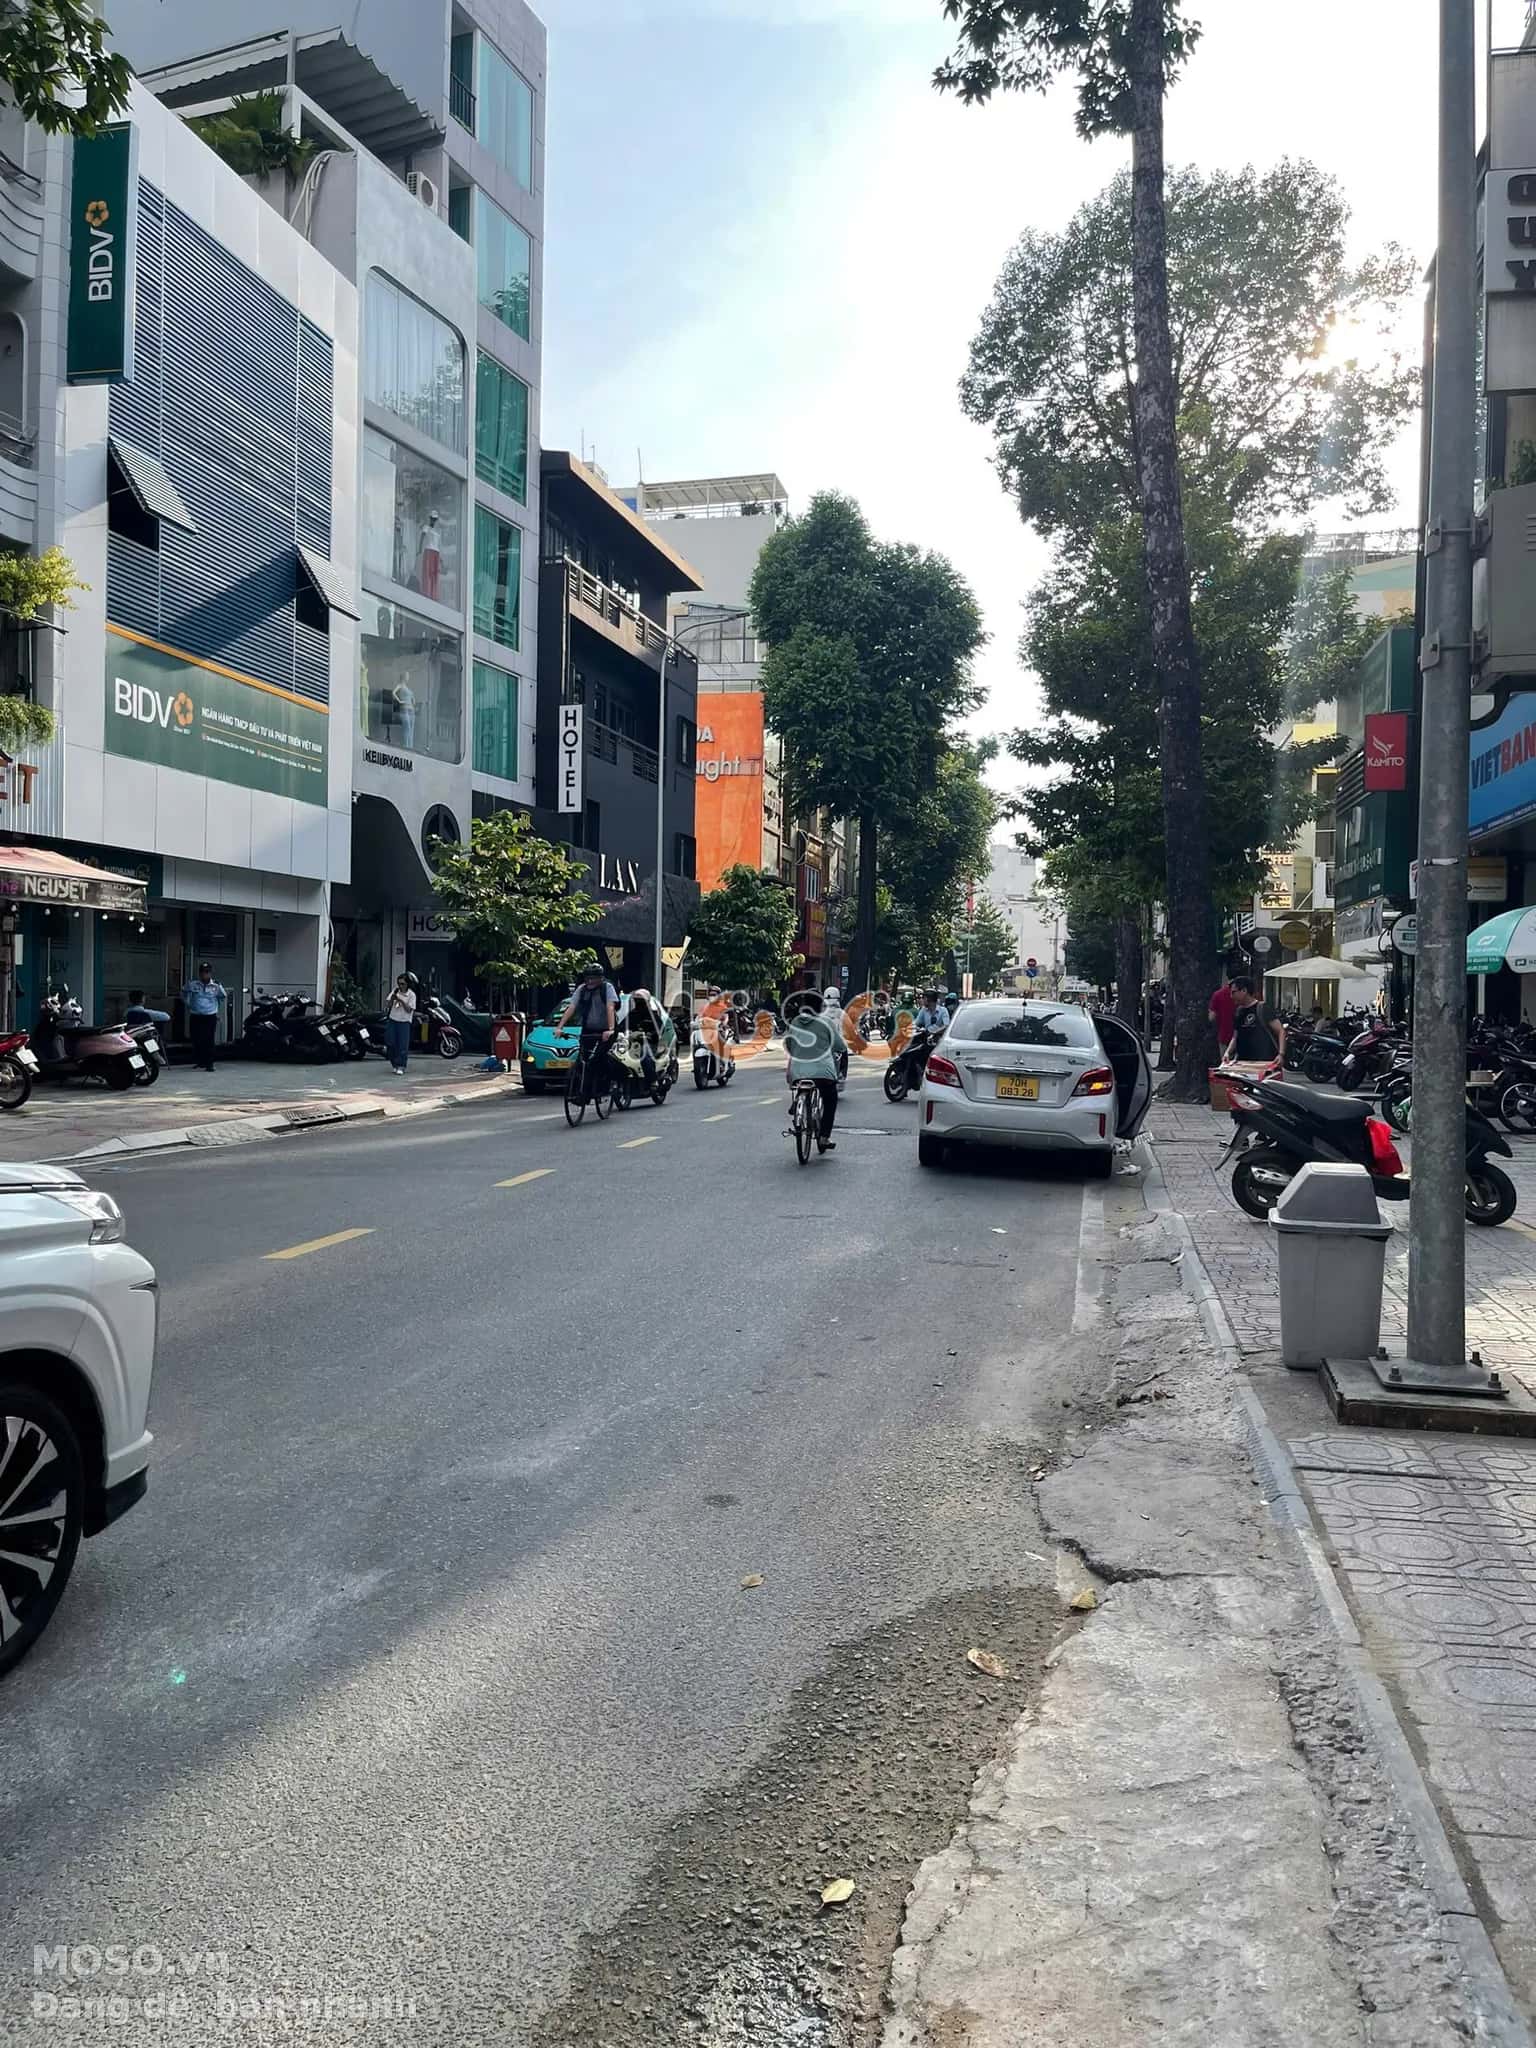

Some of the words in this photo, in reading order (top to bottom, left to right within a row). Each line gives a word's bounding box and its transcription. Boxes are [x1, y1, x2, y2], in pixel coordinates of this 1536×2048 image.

[87, 227, 115, 302] BIDV
[114, 677, 175, 729] BIDV
[562, 710, 579, 808] HOTEL
[1367, 756, 1405, 767] KAMITO
[24, 875, 89, 903] NGUYỆT
[599, 853, 640, 895] LAN
